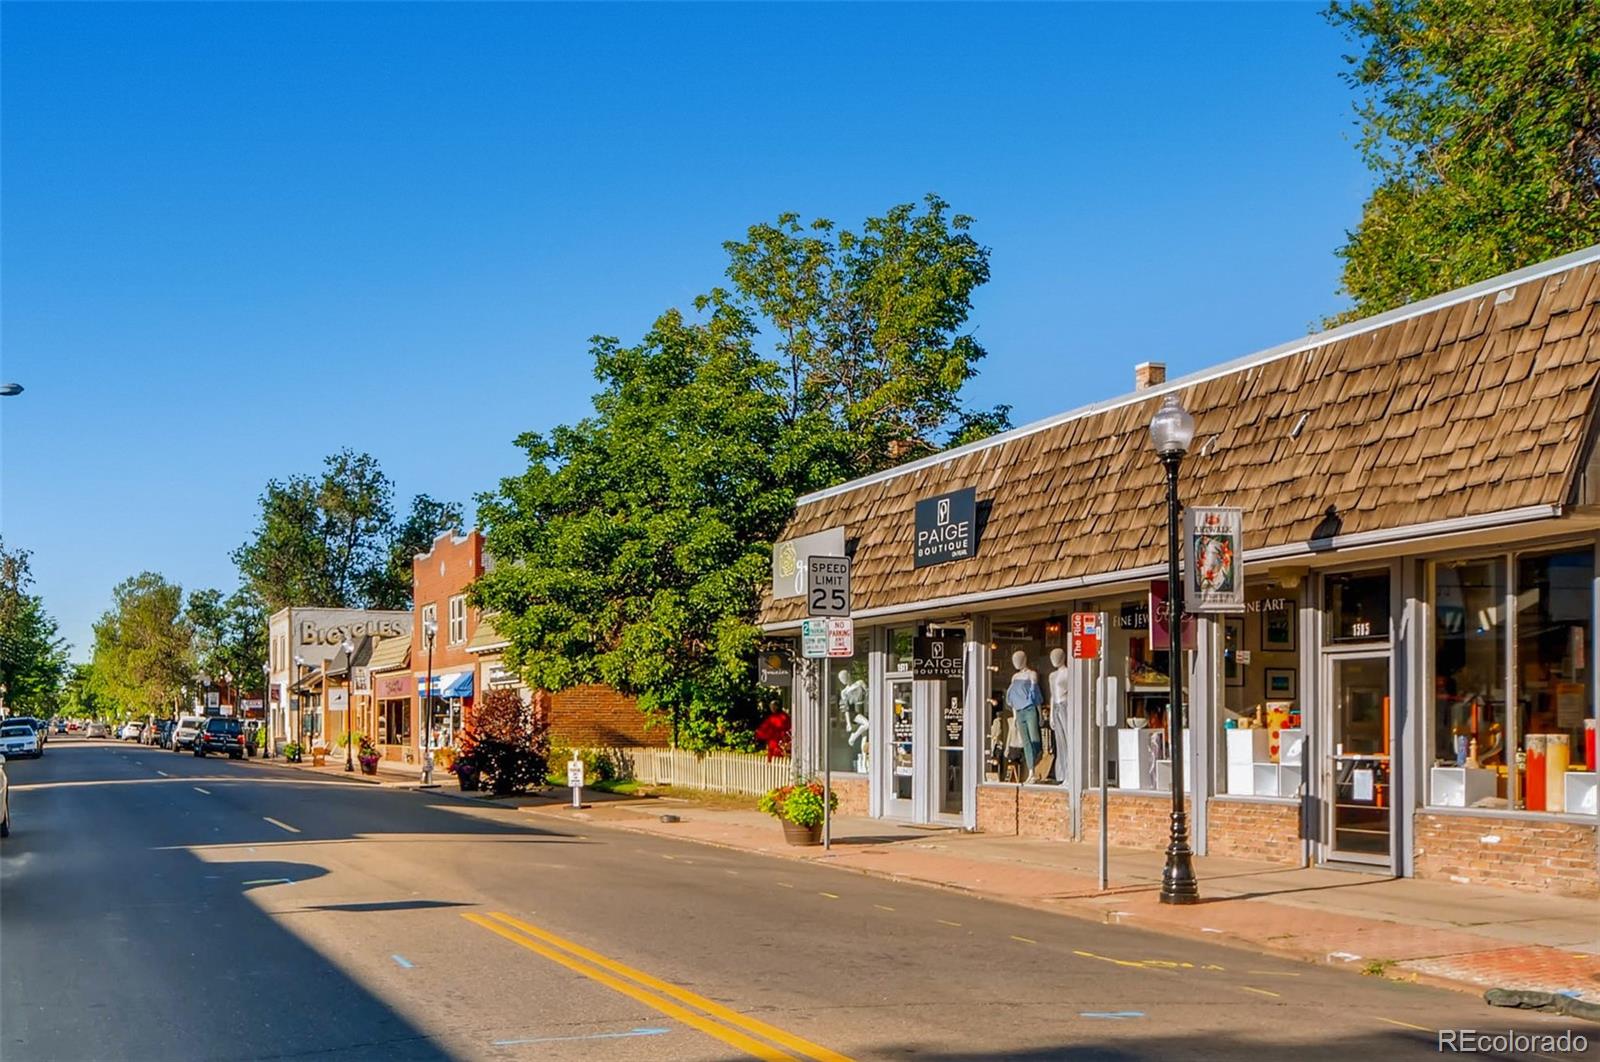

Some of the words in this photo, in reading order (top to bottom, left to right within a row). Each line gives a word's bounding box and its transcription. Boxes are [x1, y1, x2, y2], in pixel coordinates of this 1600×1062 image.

[917, 521, 969, 547] PAIGE
[917, 539, 968, 557] BOUTIQUE
[811, 562, 847, 574] SPEED
[815, 576, 843, 586] LIMIT
[811, 588, 846, 610] 25
[1247, 601, 1261, 613] NE
[1262, 598, 1286, 611] ART
[834, 621, 845, 629] NO
[1073, 614, 1082, 637] Ride
[1112, 615, 1132, 628] FINE
[1134, 612, 1150, 628] JEW
[1073, 639, 1082, 658] The
[913, 658, 962, 668] PAIGE
